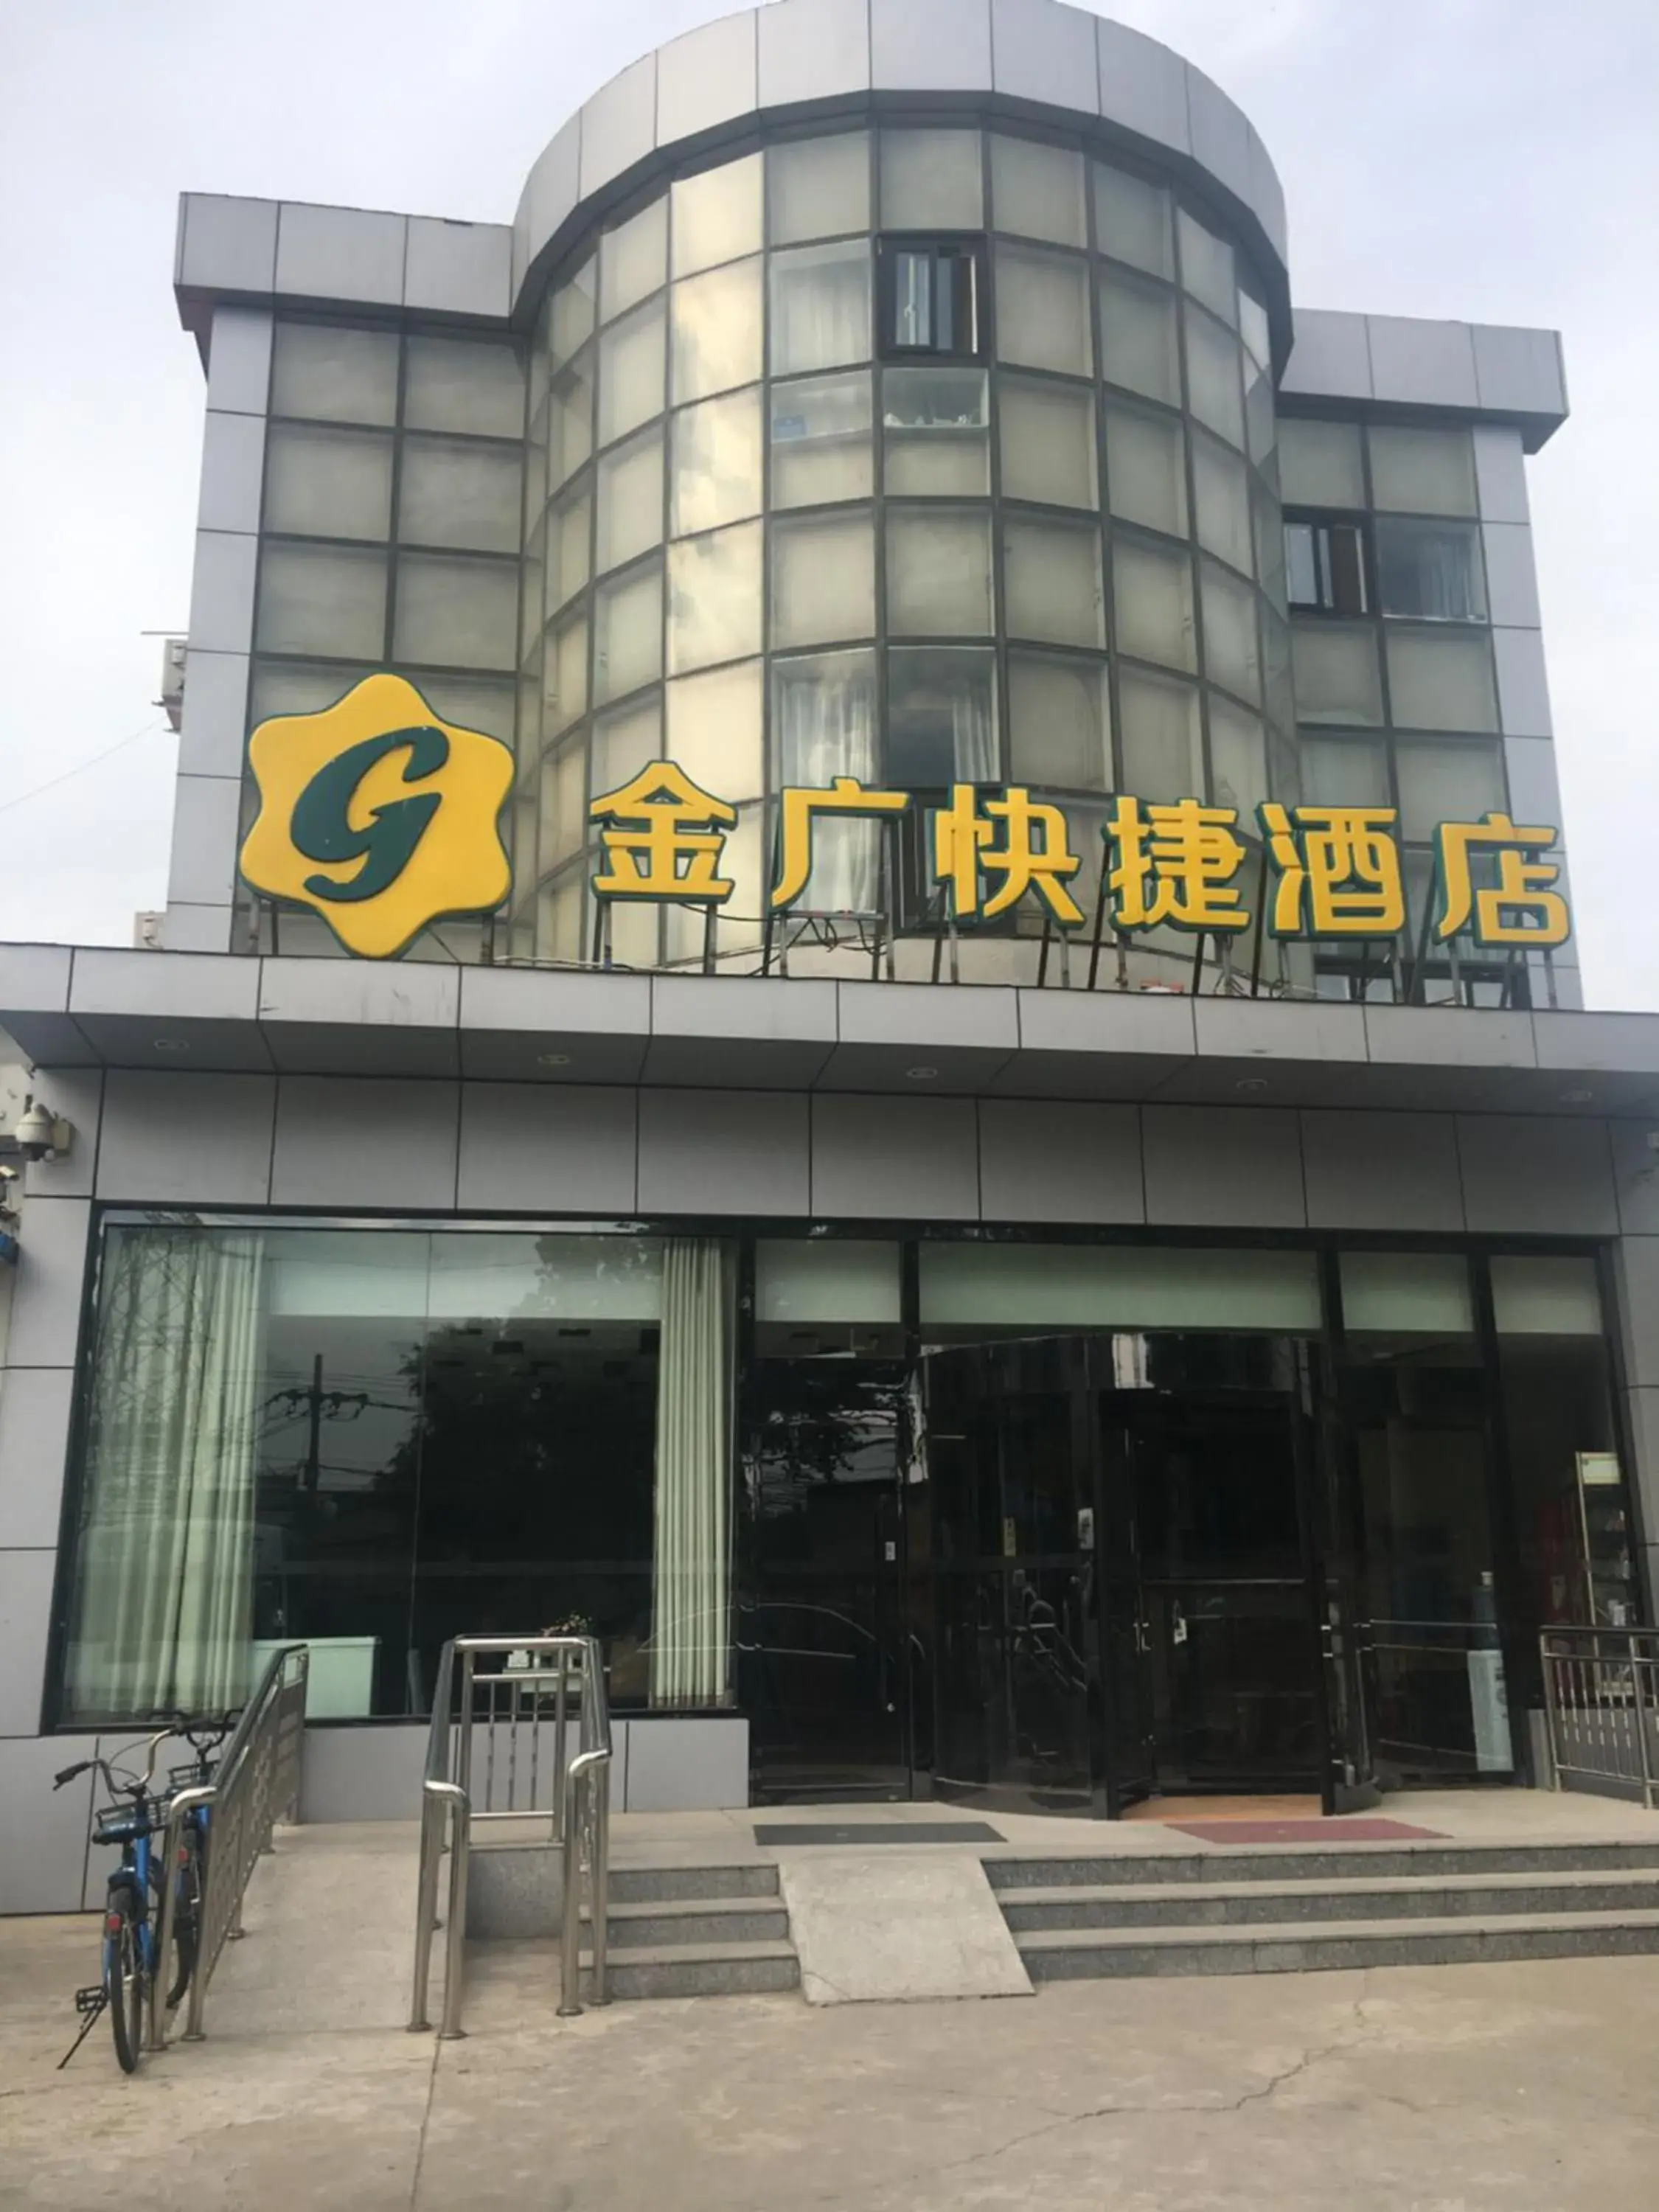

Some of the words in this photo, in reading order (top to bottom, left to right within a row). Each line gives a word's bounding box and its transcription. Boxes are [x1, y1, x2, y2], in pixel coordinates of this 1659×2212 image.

[589, 761, 1570, 946] 金广快捷酒店
